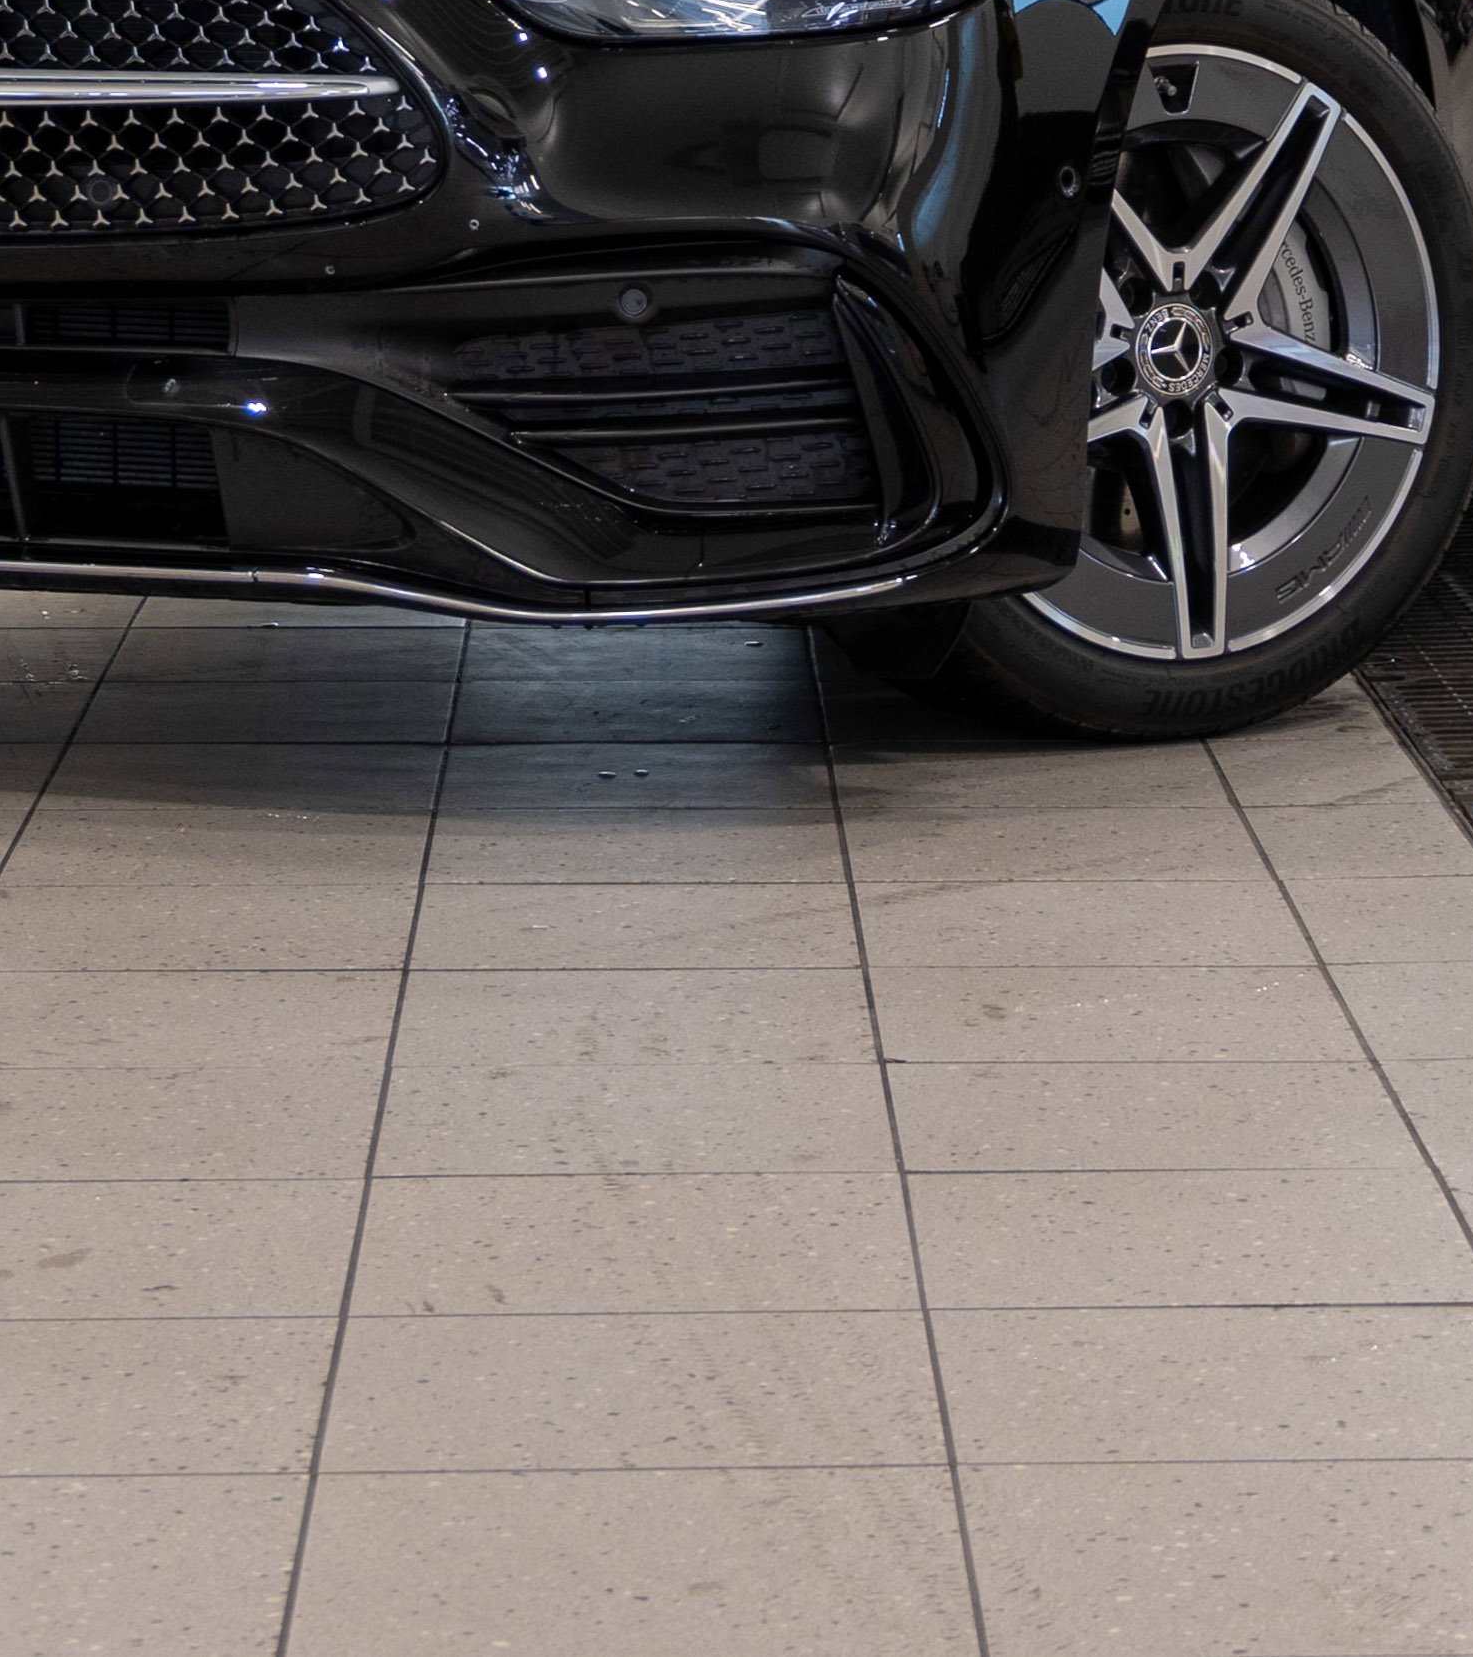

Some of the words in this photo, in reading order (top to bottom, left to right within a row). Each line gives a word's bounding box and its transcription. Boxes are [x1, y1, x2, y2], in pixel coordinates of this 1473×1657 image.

[1281, 241, 1317, 343] rcedes-Benz
[1145, 308, 1169, 334] BENZ
[1167, 353, 1211, 392] MERCEDES
